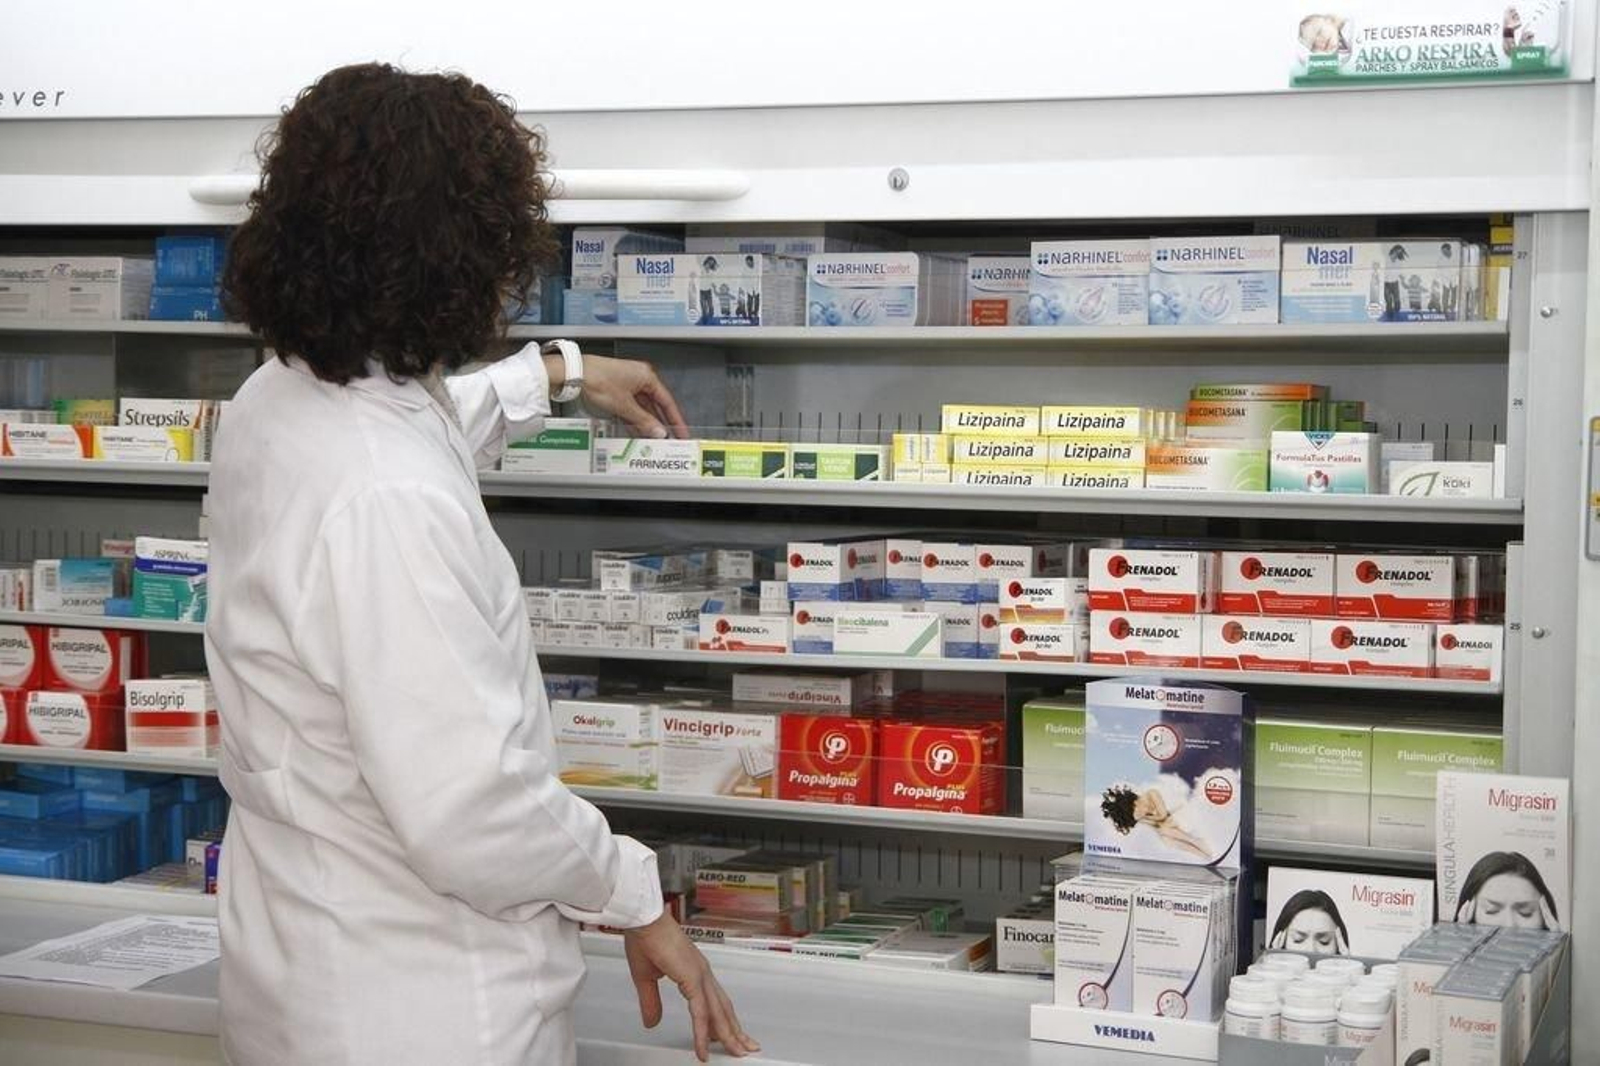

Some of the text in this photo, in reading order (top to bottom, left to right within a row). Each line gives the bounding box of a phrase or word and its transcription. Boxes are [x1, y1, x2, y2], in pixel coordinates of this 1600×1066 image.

[1380, 25, 1428, 40] CUESTA
[1430, 23, 1500, 38] RESPIRAR?
[1355, 41, 1498, 63] ARKO RESPIRA
[1356, 63, 1397, 73] PARCHES
[1401, 63, 1407, 72] Y
[1410, 61, 1440, 71] SPRAY
[575, 240, 605, 254] Nasal
[1306, 246, 1354, 265] Nasal
[636, 257, 675, 275] Nasal
[194, 311, 208, 321] PH
[125, 409, 190, 428] Strepsils
[958, 412, 1026, 431] Lizipaina
[1057, 412, 1126, 432] Lizipaina
[968, 442, 1034, 460] Lizipaina
[1064, 443, 1132, 462] Lizipaina
[1327, 453, 1362, 464] Pastillas
[629, 459, 690, 470] FARINGESIC
[966, 471, 1033, 486] Lizipaina
[1062, 473, 1130, 488] Lizipaina
[52, 642, 109, 655] HIBIGRIPAL
[130, 692, 185, 710] Bisolgrip
[788, 692, 842, 705] Vincigrip
[29, 706, 86, 719] HIBIGRIPAL
[663, 718, 735, 736] Vincigrip
[1270, 742, 1363, 760] Fluimucil Complex
[1397, 750, 1496, 767] Fluimucil Complex
[789, 769, 858, 788] Propalgina
[893, 782, 967, 801] Propalgina
[1488, 788, 1557, 812] Migrasin
[1088, 844, 1122, 854] VEMEDIA
[697, 873, 746, 883] AERO-RED
[1352, 885, 1415, 907] Migrasin
[682, 927, 724, 939] ERO-RED
[1450, 1015, 1496, 1034] Migrasin
[1094, 1025, 1156, 1042] VEMEDIA
